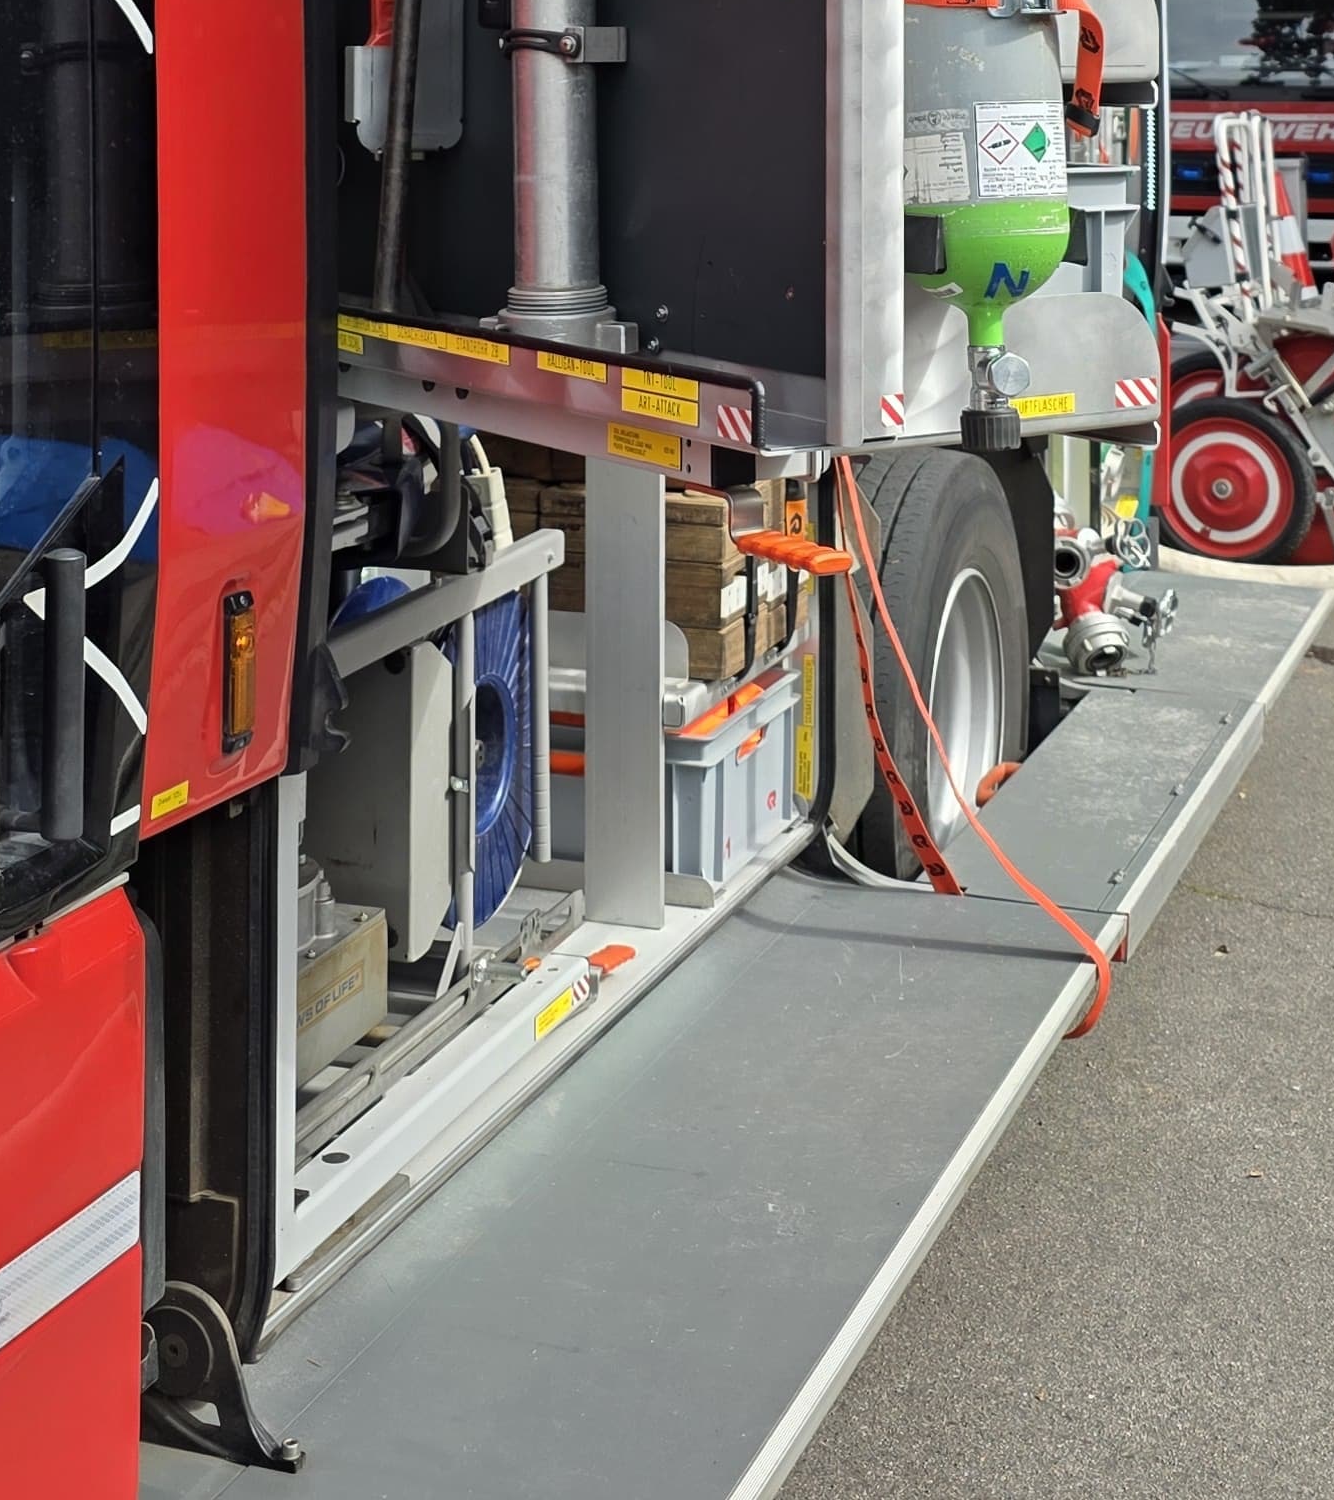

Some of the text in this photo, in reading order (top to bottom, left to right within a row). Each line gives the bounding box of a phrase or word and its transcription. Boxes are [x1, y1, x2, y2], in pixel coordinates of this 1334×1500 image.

[642, 368, 677, 392] TNT-TOOL
[638, 394, 681, 418] ART-ATTACK
[1017, 396, 1068, 414] UFTFLASCHE
[316, 992, 332, 1014] OF
